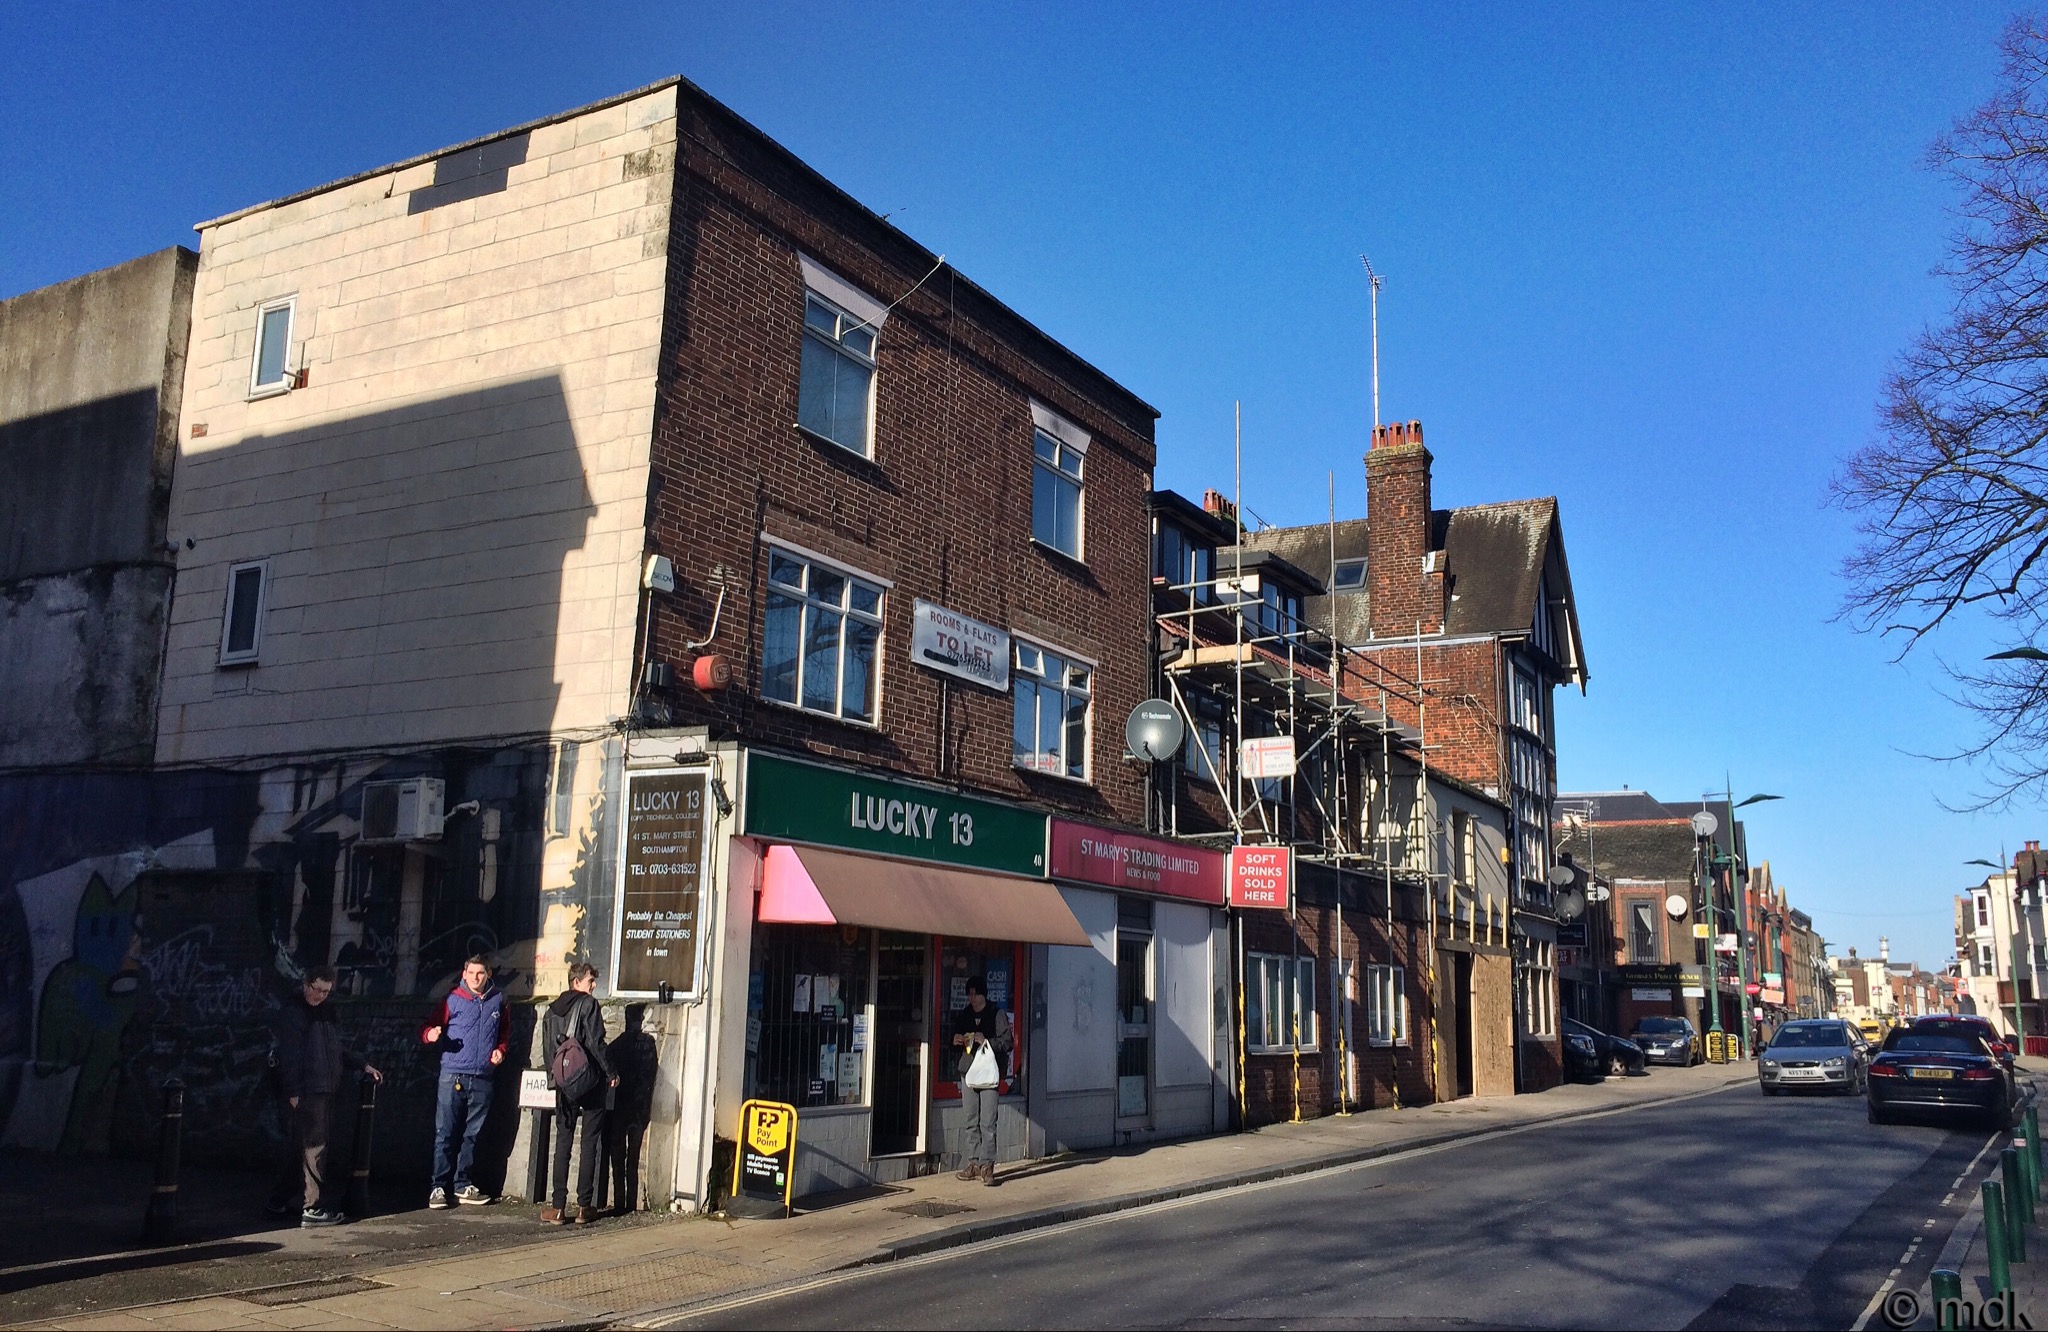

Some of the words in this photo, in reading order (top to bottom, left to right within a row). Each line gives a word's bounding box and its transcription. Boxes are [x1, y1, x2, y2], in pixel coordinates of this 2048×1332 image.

[930, 610, 961, 632] ROOMS
[964, 624, 970, 636] &
[972, 627, 997, 646] FLATS
[936, 631, 959, 653] TO
[963, 641, 994, 664] LET
[633, 790, 680, 812] LUCKY
[686, 790, 700, 810] 13
[851, 791, 938, 840] LUCKY
[949, 812, 974, 847] 13
[642, 832, 652, 840] ST.
[653, 832, 672, 840] MARY
[672, 830, 698, 840] STREET,
[642, 845, 688, 854] SOUTHAMPTON
[1034, 854, 1042, 867] 40
[1081, 838, 1094, 856] ST
[1094, 842, 1129, 862] MARY'S
[1130, 848, 1167, 870] TRADING
[1168, 857, 1200, 876] LIMITED
[1244, 853, 1276, 865] SOFT
[630, 864, 648, 876] TEL:
[649, 862, 697, 875] 0703-631522
[1126, 866, 1141, 880] NEWS
[1142, 868, 1147, 880] &
[1147, 869, 1161, 882] FOOD
[1238, 866, 1283, 877] DRINKS
[1244, 878, 1276, 890] SOLD
[1244, 890, 1276, 902] HERE
[626, 910, 653, 922] Probably
[654, 910, 664, 920] the
[666, 910, 693, 922] Cheapest
[626, 929, 656, 940] STUDENT
[656, 928, 692, 940] STATIONERS
[646, 947, 652, 957] in
[653, 947, 669, 957] town
[986, 970, 1007, 982] CASH
[986, 990, 1006, 1002] HERE
[526, 1079, 546, 1090] HAR
[524, 1094, 536, 1102] City
[757, 1128, 772, 1140] Pay
[756, 1137, 778, 1148] Point
[754, 1155, 779, 1164] payments
[746, 1160, 763, 1170] Mobile
[763, 1163, 780, 1172] top-up
[754, 1168, 771, 1177] licence
